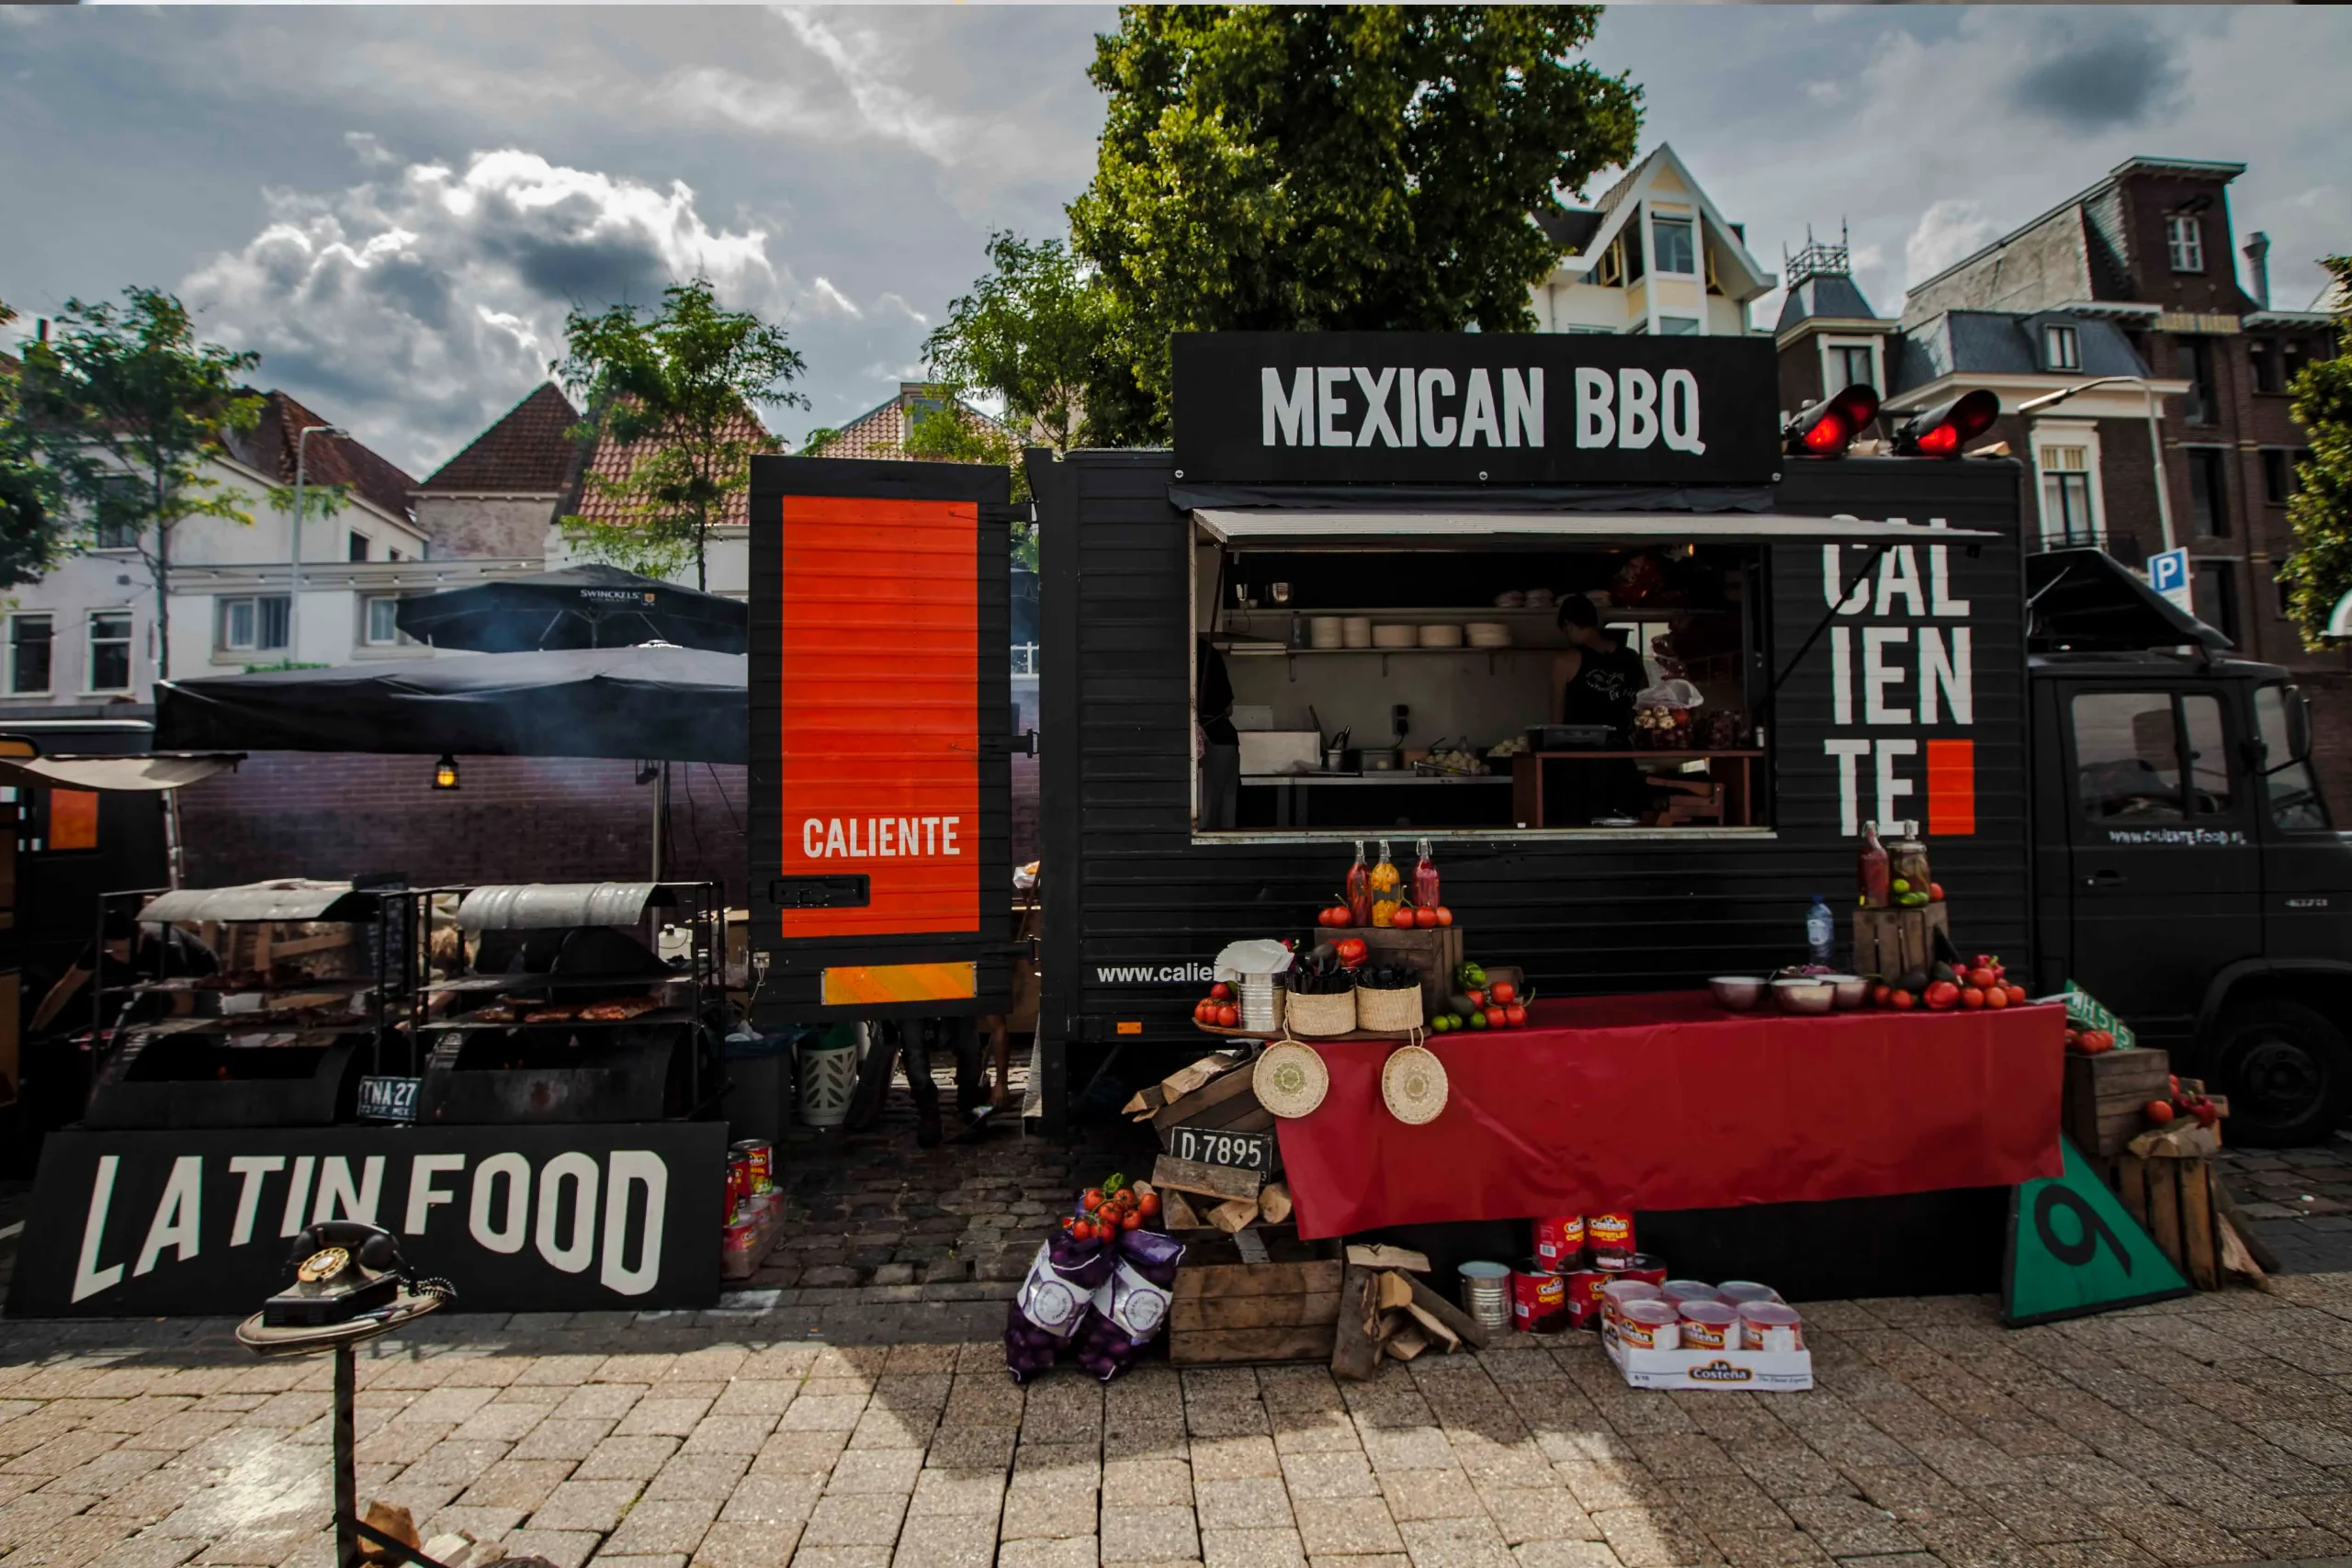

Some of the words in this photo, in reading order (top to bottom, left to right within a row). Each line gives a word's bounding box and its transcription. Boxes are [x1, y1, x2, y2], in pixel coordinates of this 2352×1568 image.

[1261, 367, 1545, 448] MEXICAN
[1575, 367, 1706, 456] BBQ
[1823, 514, 1971, 616] CAL
[2157, 556, 2177, 589] P
[1831, 626, 1973, 725] IEN
[1824, 739, 1919, 837] TE
[803, 817, 960, 858] CALIENTE
[1097, 963, 1215, 983] www.calie
[72, 1155, 386, 1305] LATIN
[404, 1151, 668, 1296] FOOD
